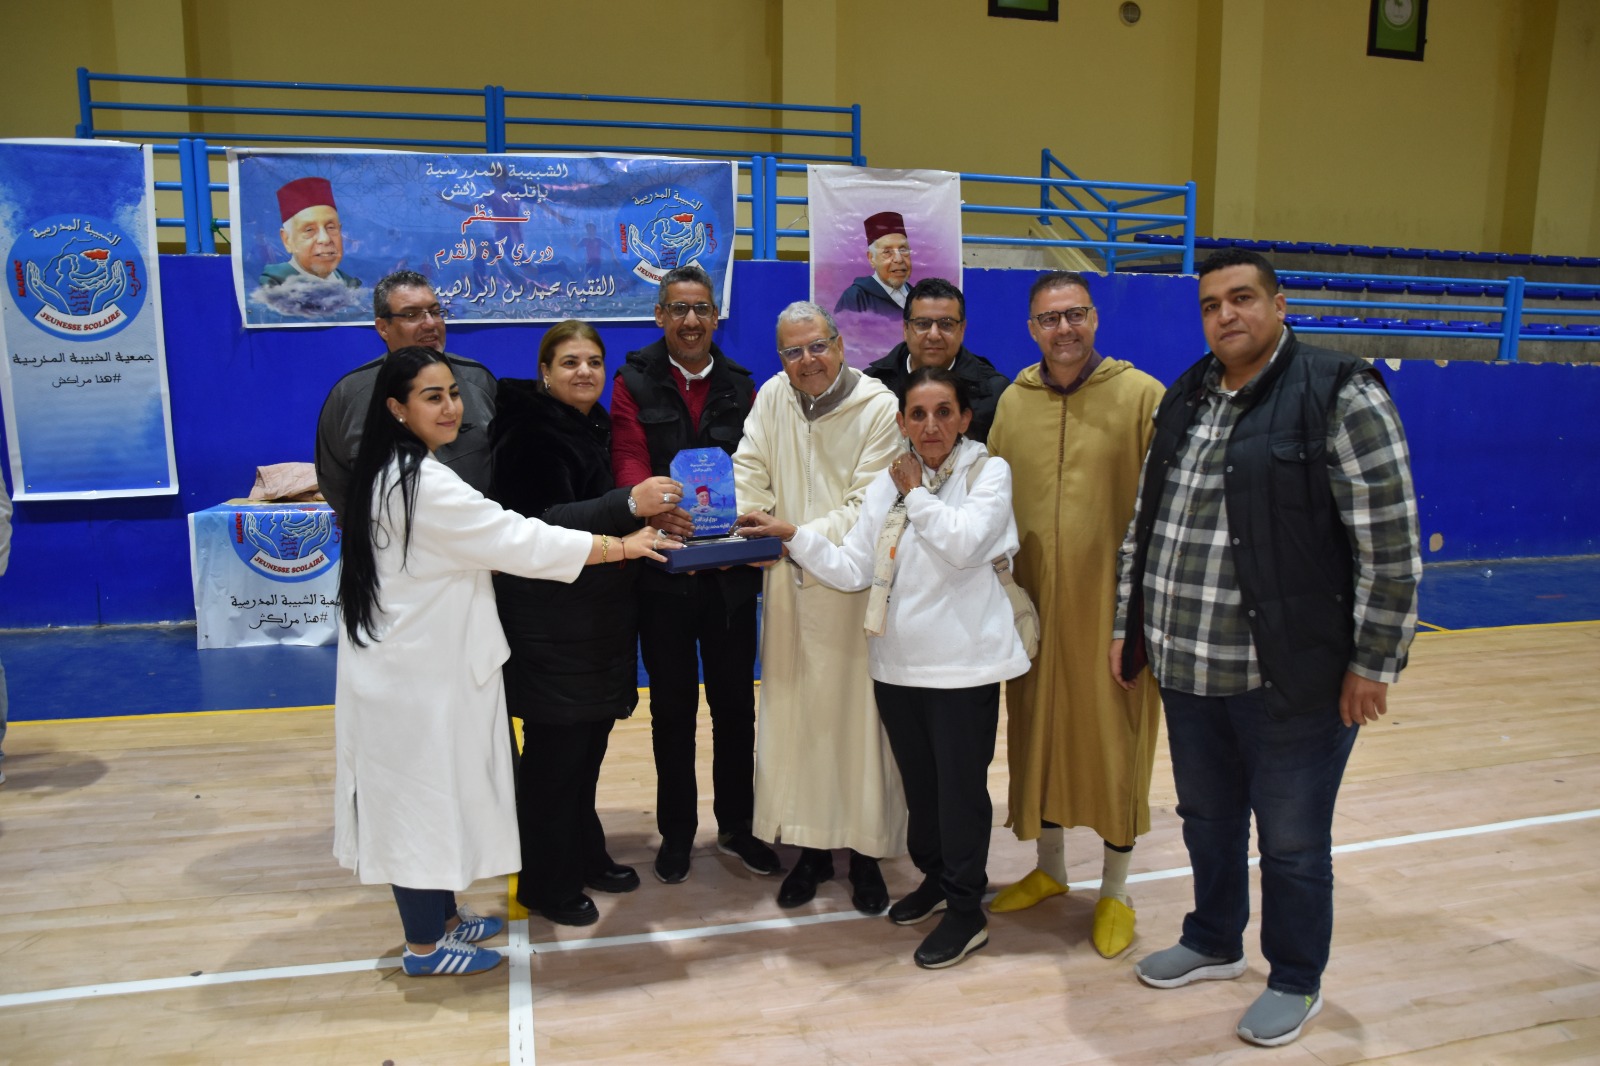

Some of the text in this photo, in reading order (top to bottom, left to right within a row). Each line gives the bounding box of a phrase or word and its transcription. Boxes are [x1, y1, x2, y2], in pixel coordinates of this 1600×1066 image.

[426, 162, 568, 180] الشبيبة المدرسية
[441, 181, 549, 203] بإقليم مراكش
[632, 187, 703, 211] الشبيبة المدرسية
[30, 218, 122, 246] الشبيبة المدرسية
[434, 236, 554, 269] دوري كرة القدم
[14, 259, 26, 297] MAROC
[637, 265, 663, 281] JEUNES
[502, 283, 524, 303] بن
[527, 281, 561, 300] محمد
[567, 275, 615, 303] الفقيه
[40, 309, 121, 331] JEUNESSE SCOLAIRE
[13, 351, 154, 367] جمعية الشبيبة المدرسية
[52, 373, 122, 388] #هنا مراكش
[254, 554, 325, 573] JEUNESSE SCOLAIRE
[230, 593, 341, 609] معية الشبيبة المدرسية
[249, 612, 328, 629] #هنا مراكش
